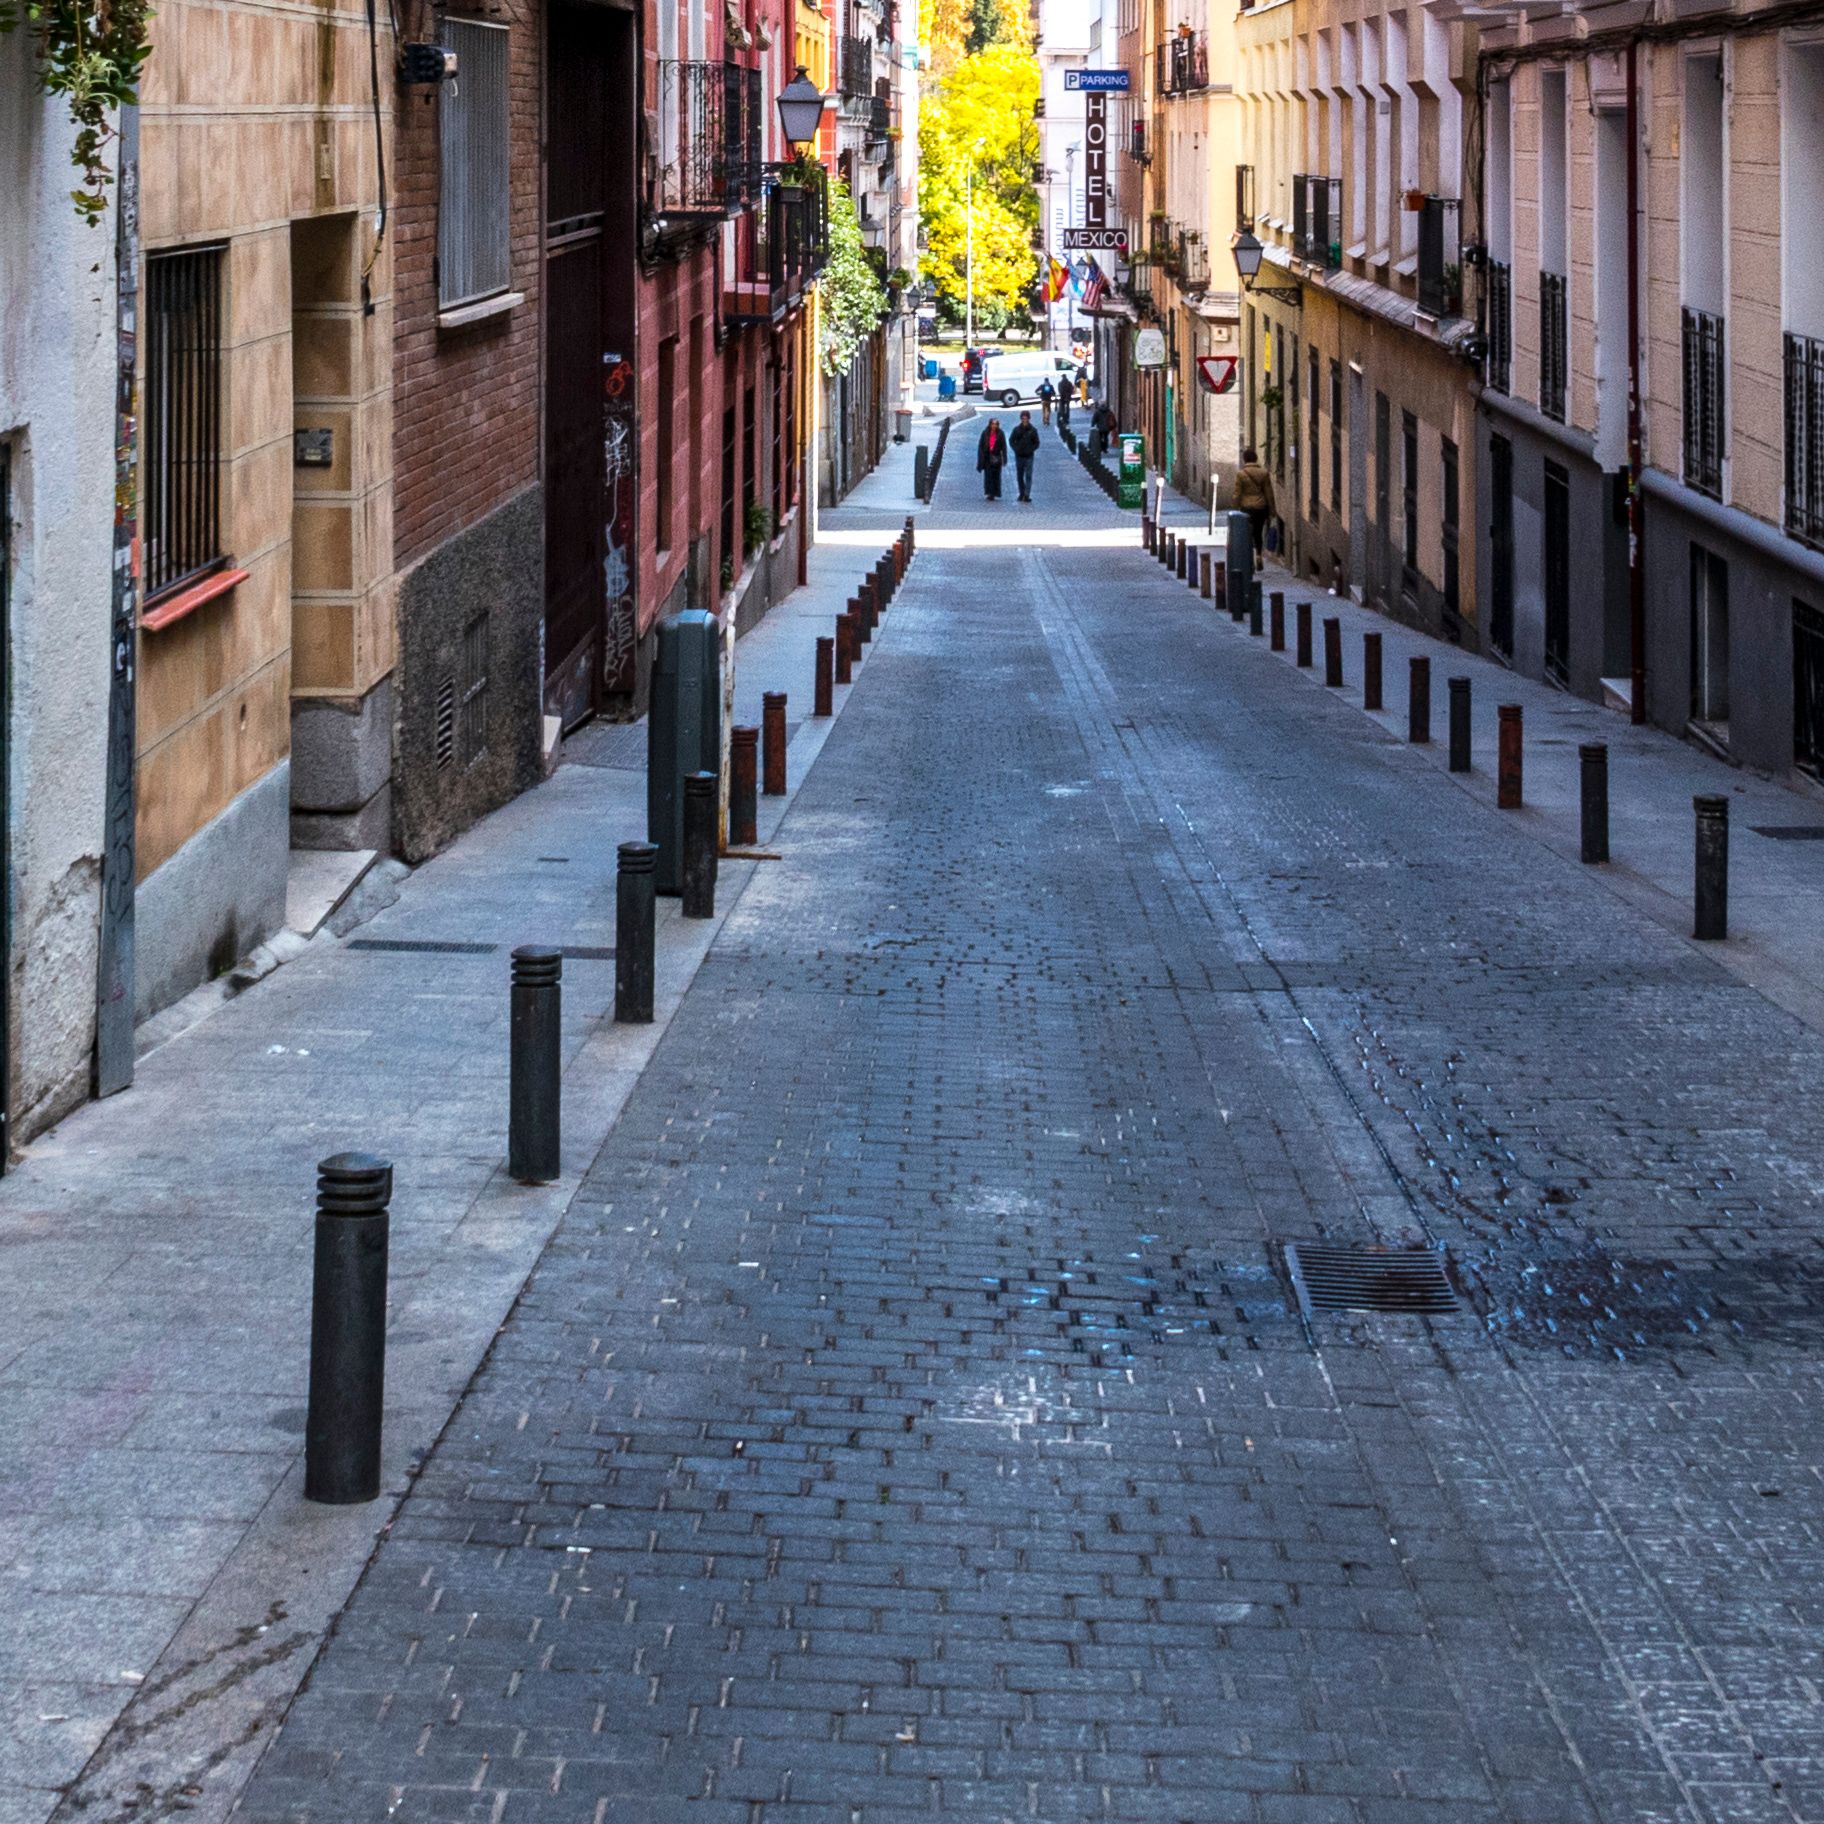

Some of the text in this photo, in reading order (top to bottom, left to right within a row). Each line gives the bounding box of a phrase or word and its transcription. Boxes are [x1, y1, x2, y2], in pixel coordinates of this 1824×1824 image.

[1068, 74, 1129, 86] P PARKING
[1087, 97, 1105, 223] HOTEL
[1065, 231, 1127, 247] MEXICO
